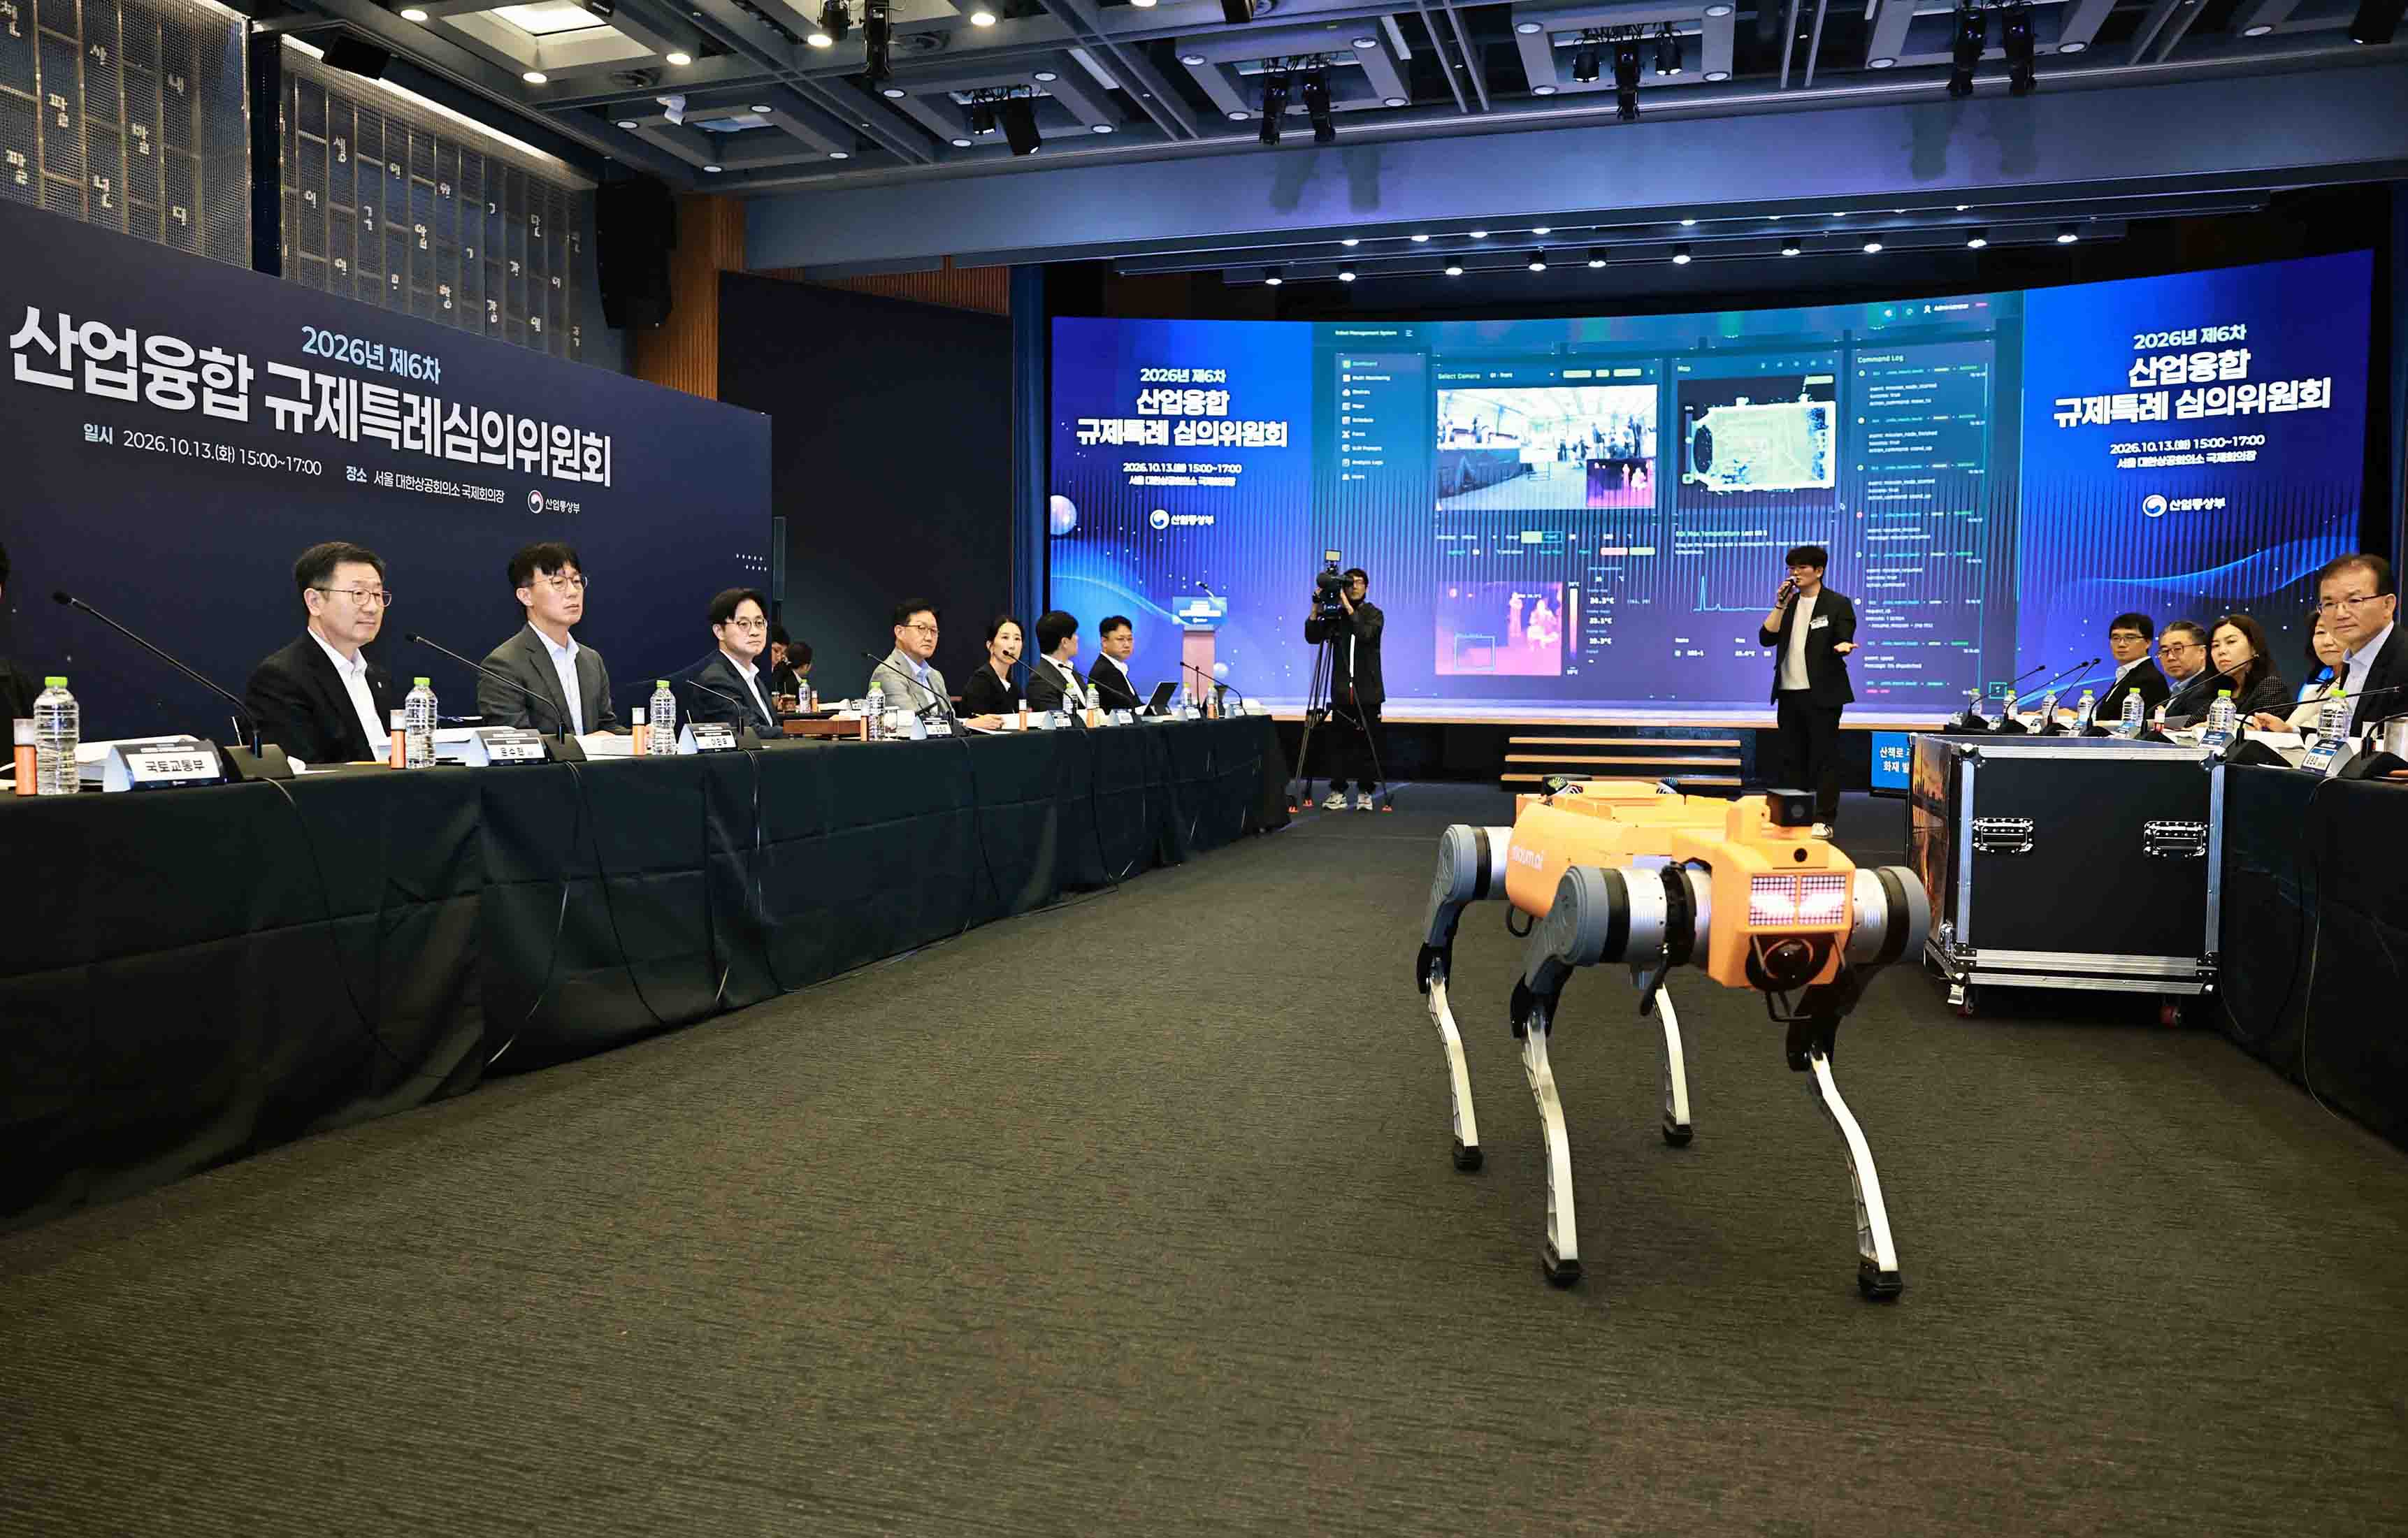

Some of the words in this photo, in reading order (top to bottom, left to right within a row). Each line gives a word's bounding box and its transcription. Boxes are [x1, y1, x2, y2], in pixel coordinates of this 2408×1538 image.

[2133, 328, 2197, 349] 2026년
[2200, 324, 2247, 344] 제6차
[302, 326, 384, 372] 2026년
[389, 347, 441, 385] 제6차
[2129, 348, 2251, 388] 산업융합
[1140, 368, 1190, 383] 2026년
[1192, 368, 1227, 384] 제6차
[10, 305, 255, 422] 산업융합
[266, 361, 612, 486] 규제특례심의위원회
[1137, 389, 1230, 416] 산업융합
[2054, 391, 2169, 428] 규제특례
[2175, 377, 2332, 420] 심의위원회
[1076, 419, 1169, 446] 규제특례
[1174, 421, 1288, 447] 심의위원회
[84, 423, 113, 444] 일시
[123, 430, 235, 463] 2026.10.13.(화)
[240, 449, 322, 475] 15:00~17:00
[346, 465, 368, 483] 장소
[374, 470, 394, 487] 서울
[396, 474, 461, 498] 대한상공회의소
[461, 484, 505, 503] 국제회의장
[545, 498, 580, 514] 산업통상부
[1880, 746, 1904, 759] 산책로
[1883, 760, 1900, 772] 화재
[145, 760, 205, 773] 국토교통부
